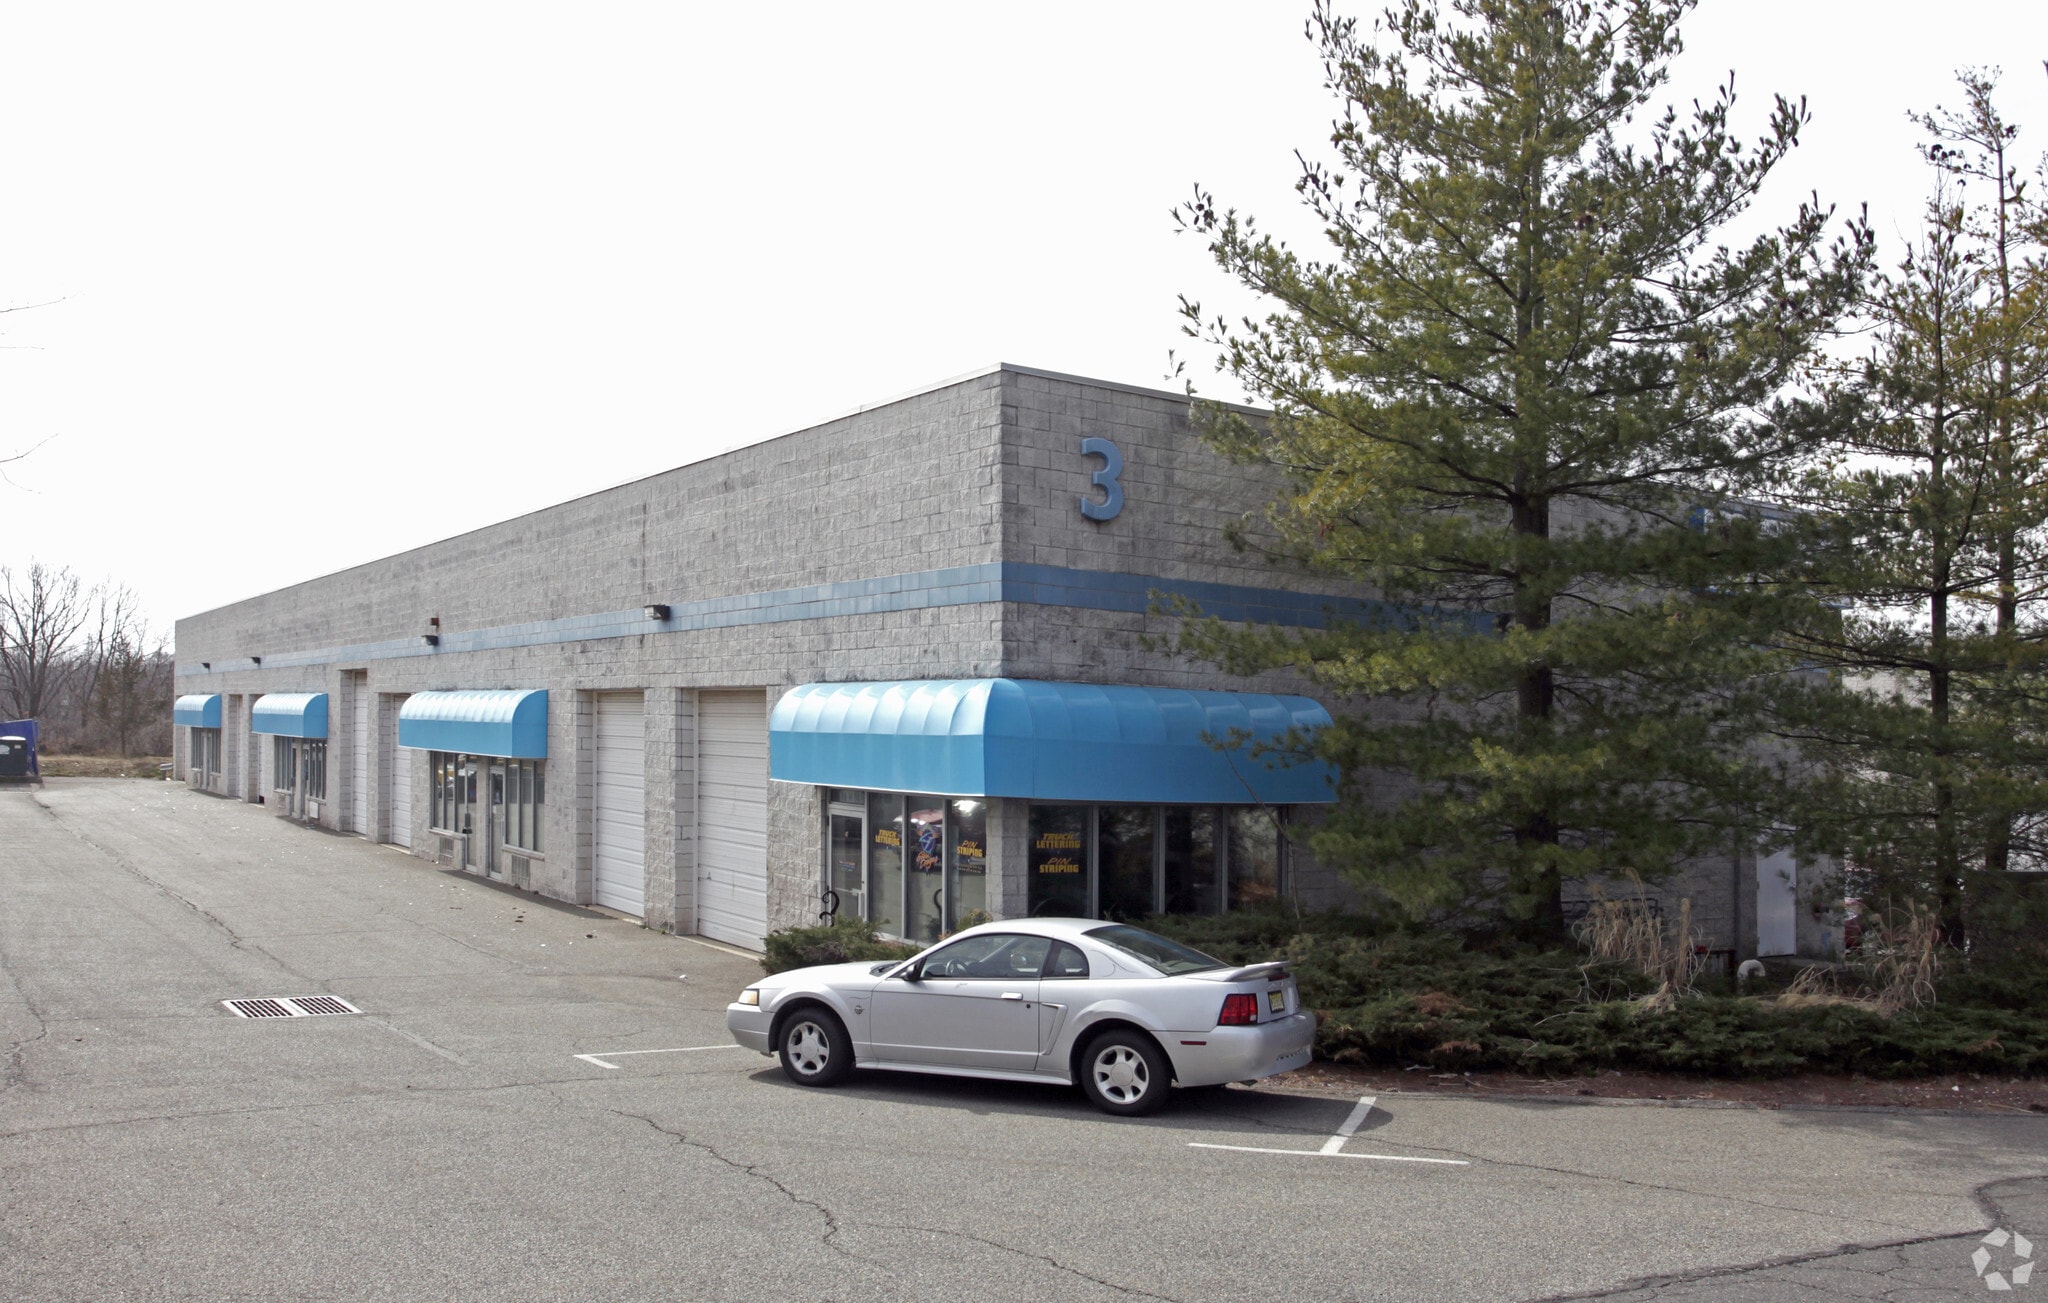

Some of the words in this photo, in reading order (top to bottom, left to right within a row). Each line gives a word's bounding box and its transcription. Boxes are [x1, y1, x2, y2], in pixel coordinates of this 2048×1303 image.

[1080, 437, 1125, 521] 3
[962, 840, 977, 848] PIN
[1036, 840, 1081, 848] LETTERING
[1048, 857, 1072, 865] PIN
[1040, 864, 1079, 873] STRIPING
